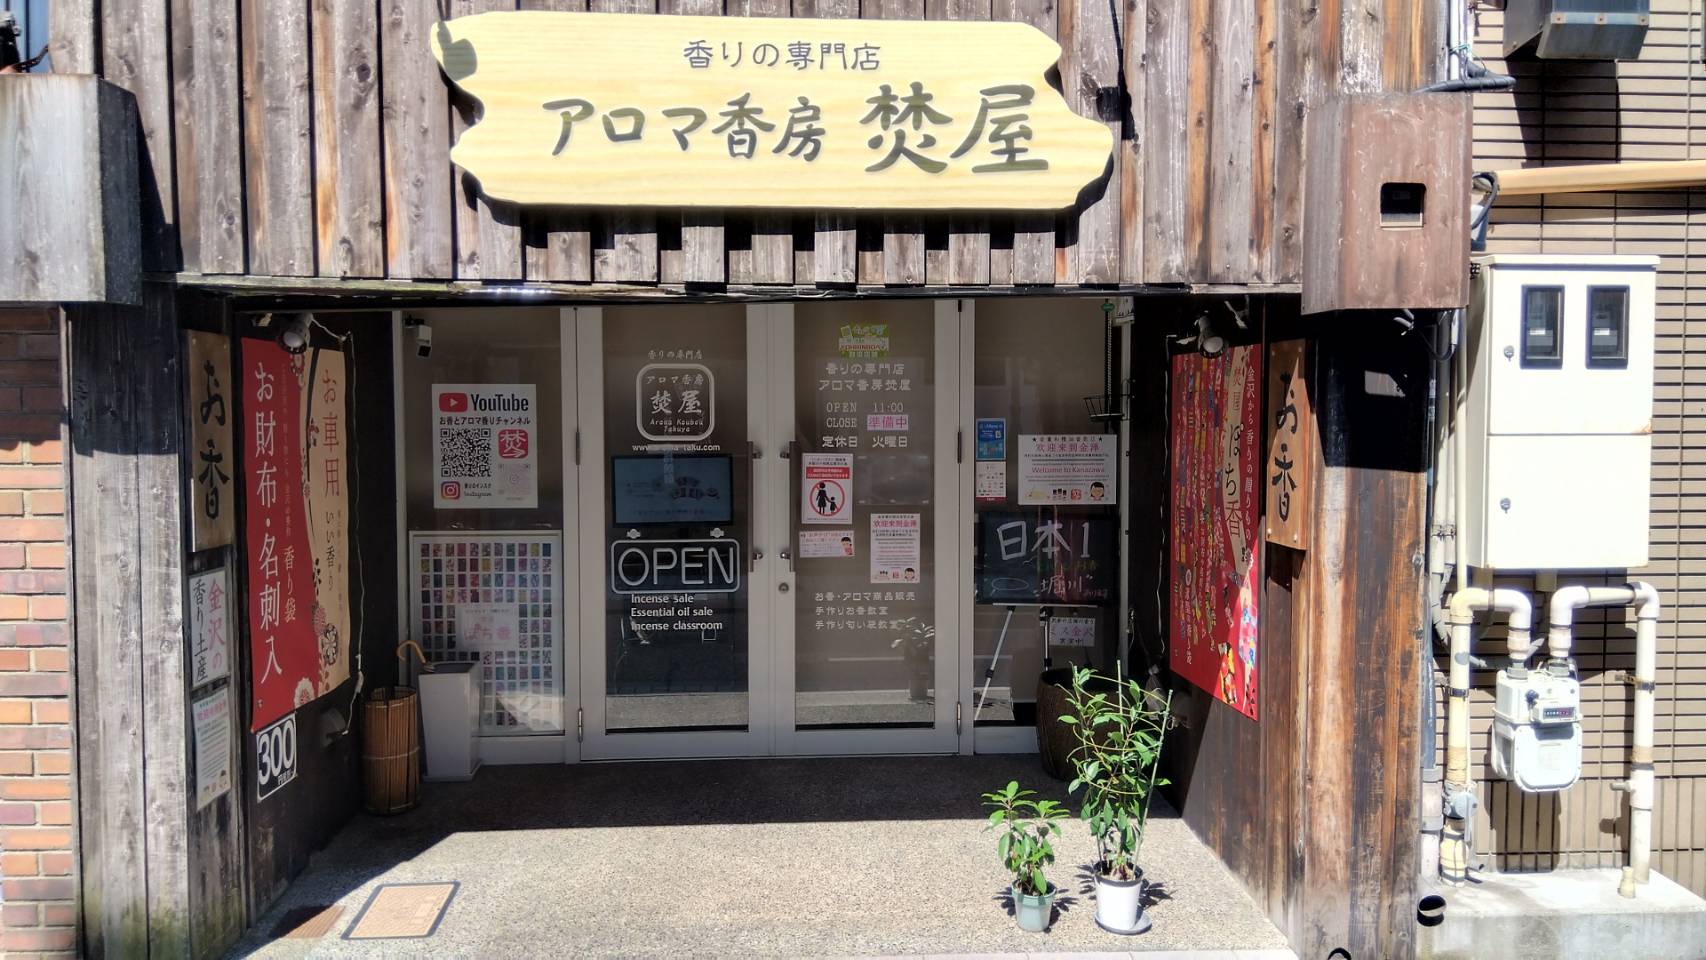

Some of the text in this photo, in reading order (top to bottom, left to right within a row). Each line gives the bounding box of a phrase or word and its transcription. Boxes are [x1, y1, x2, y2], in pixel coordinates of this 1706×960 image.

[683, 40, 882, 72] 香りの専門店
[543, 82, 1049, 173] アロマ香房 焚屋
[825, 363, 905, 375] 香りの専門店
[471, 394, 529, 411] YouTube
[650, 390, 702, 414] 焚屋
[826, 402, 904, 412] OPEN 11:00
[826, 417, 857, 428] CLOSE
[199, 360, 230, 519] お香
[822, 436, 908, 447] 定休日 火曜日
[1272, 371, 1297, 522] お香
[618, 547, 734, 586] OPEN
[631, 593, 694, 604] Incense sale
[631, 607, 713, 617] Essential oil sale
[208, 577, 226, 670] 金沢の
[631, 620, 723, 631] Incense classroom
[259, 718, 294, 786] 300
